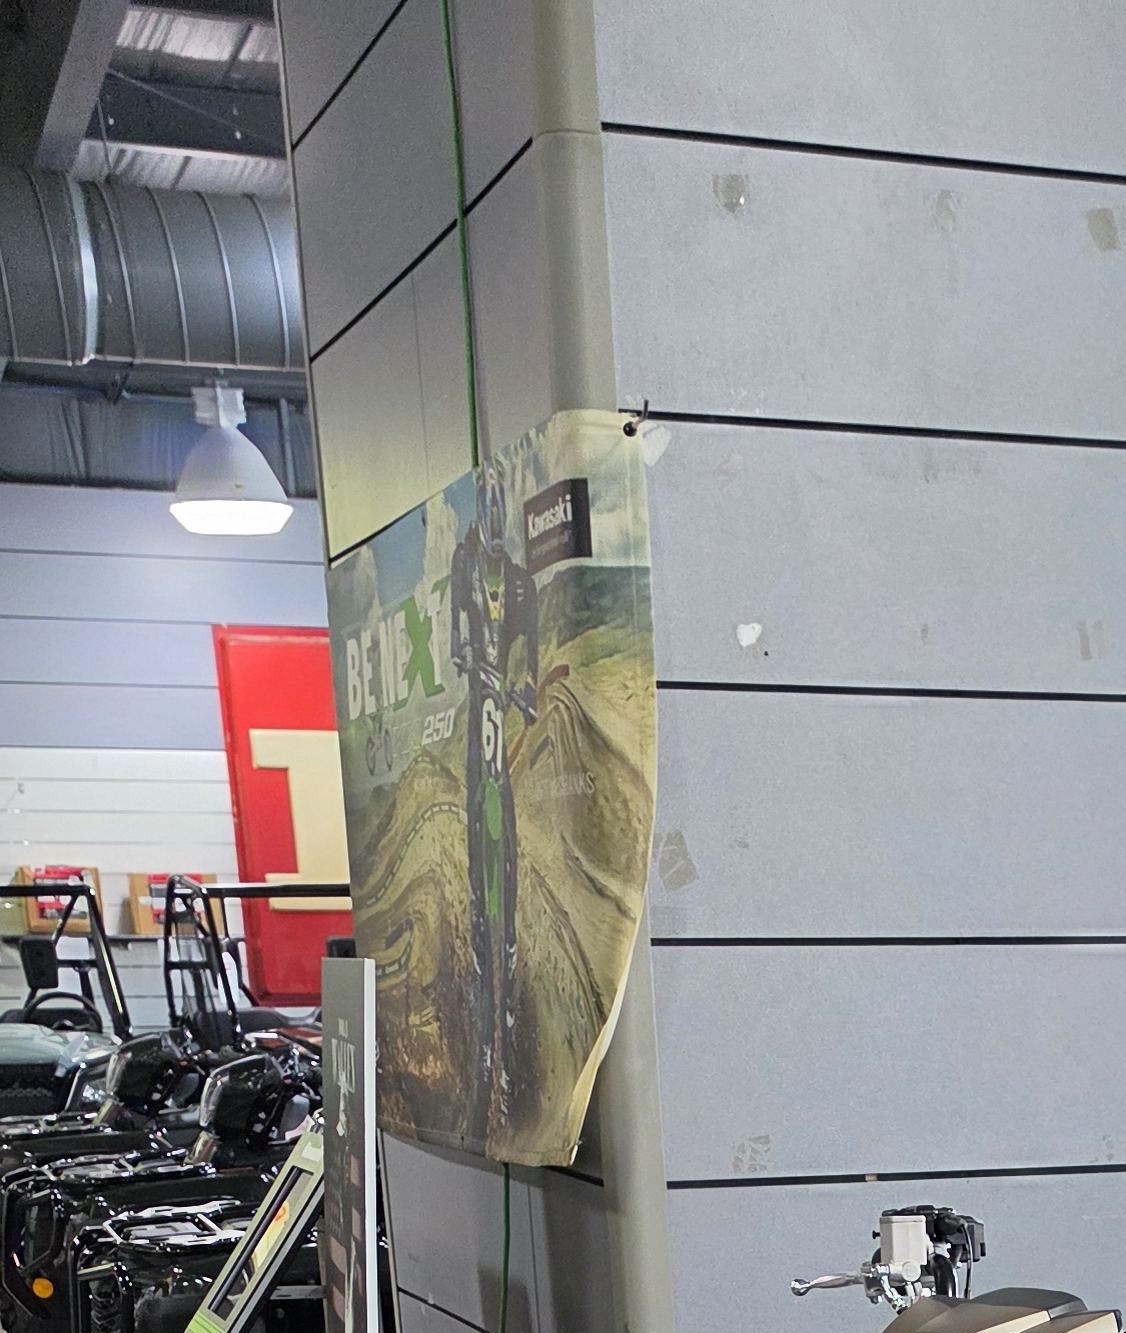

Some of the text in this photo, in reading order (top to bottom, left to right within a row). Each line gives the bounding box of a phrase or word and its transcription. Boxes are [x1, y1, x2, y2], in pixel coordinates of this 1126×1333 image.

[527, 493, 573, 540] Kawasaki
[346, 573, 450, 720] BE NEXT
[421, 707, 456, 746] 250
